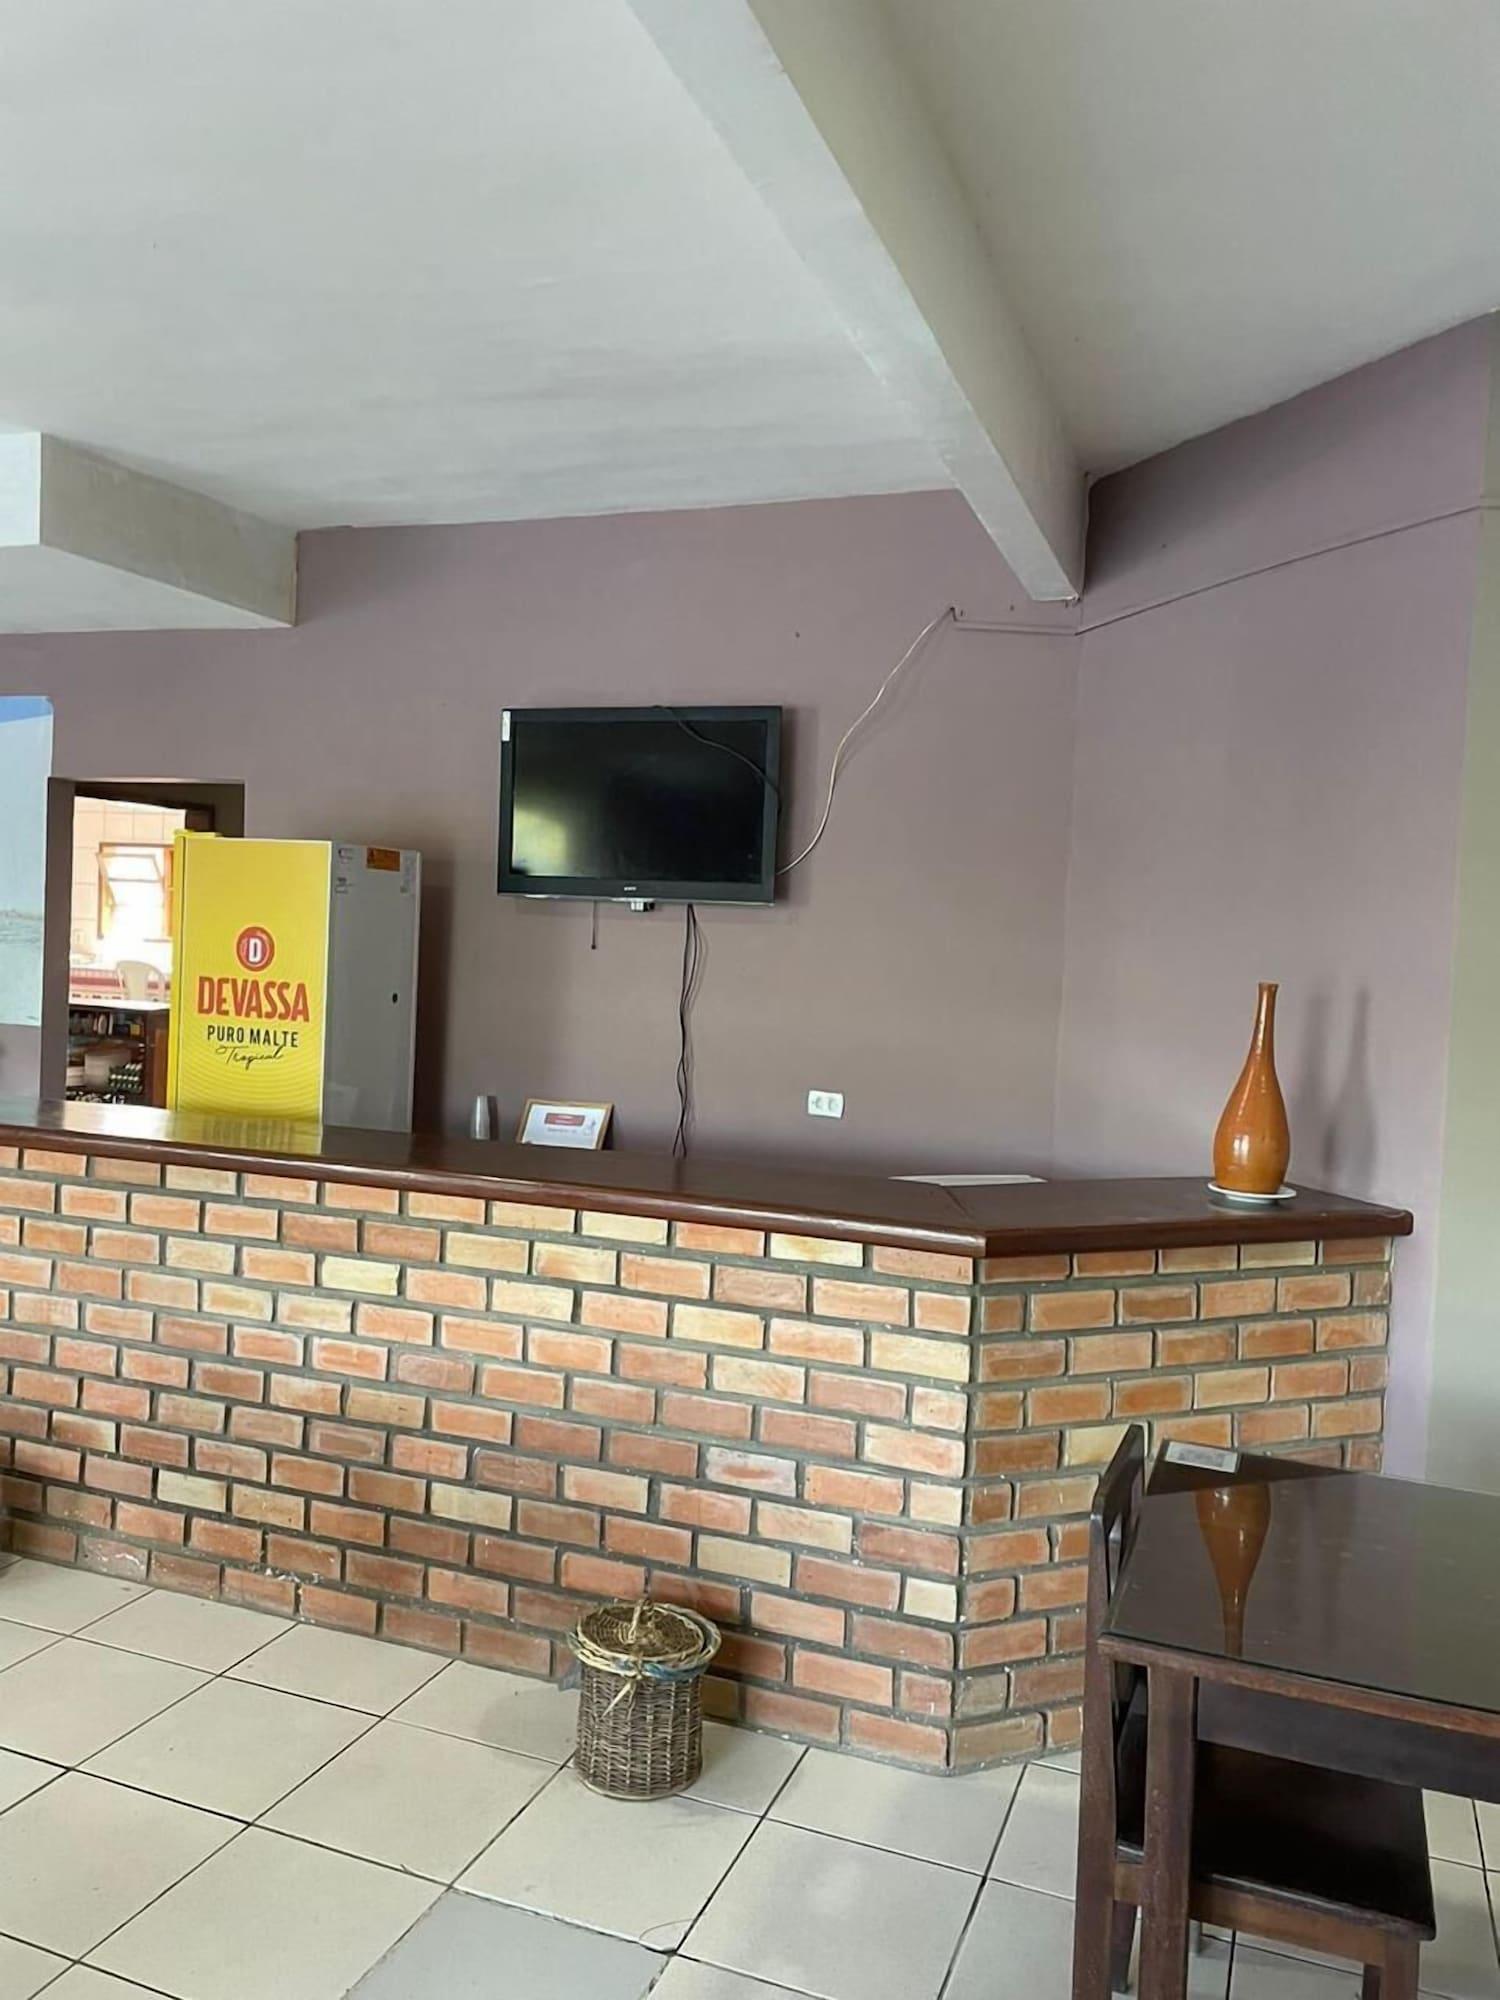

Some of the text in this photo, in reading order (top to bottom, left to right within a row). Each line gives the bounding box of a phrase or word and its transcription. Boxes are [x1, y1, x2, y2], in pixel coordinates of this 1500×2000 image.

[248, 937, 263, 963] D
[198, 976, 310, 1023] DEVASSA
[207, 1025, 299, 1048] PURO MALTE
